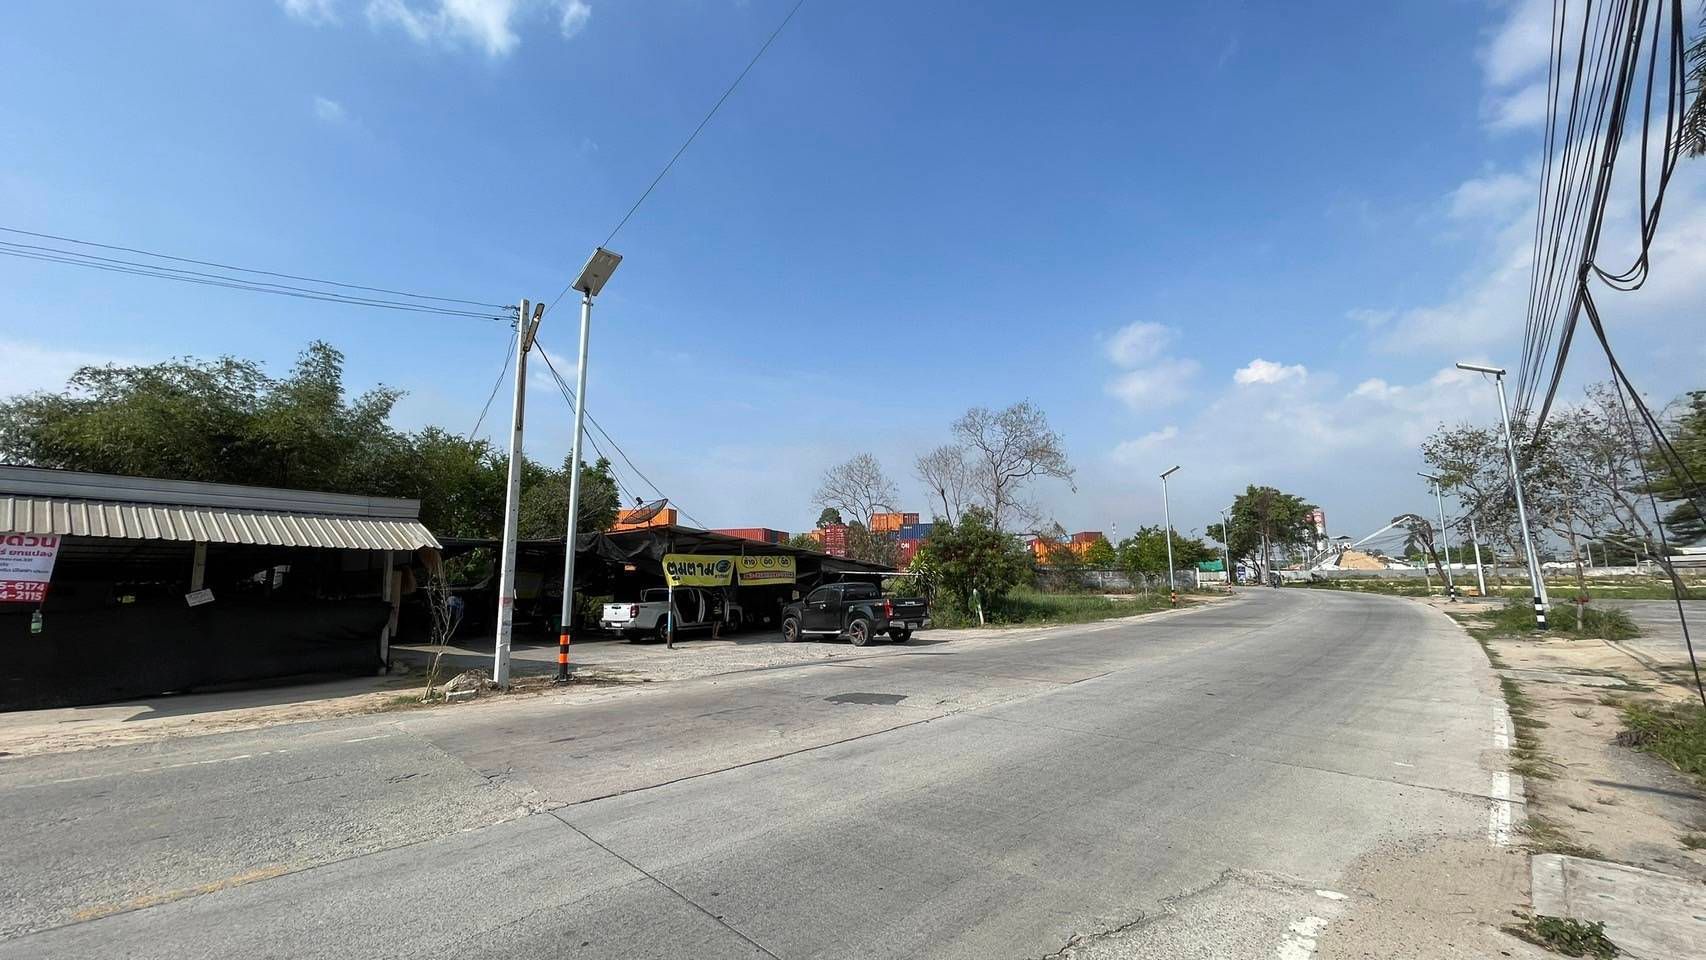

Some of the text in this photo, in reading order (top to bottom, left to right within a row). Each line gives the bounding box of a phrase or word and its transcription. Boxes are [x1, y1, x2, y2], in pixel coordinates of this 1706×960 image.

[666, 561, 716, 580] ตูมตาม
[0, 591, 43, 600] 4-2115
